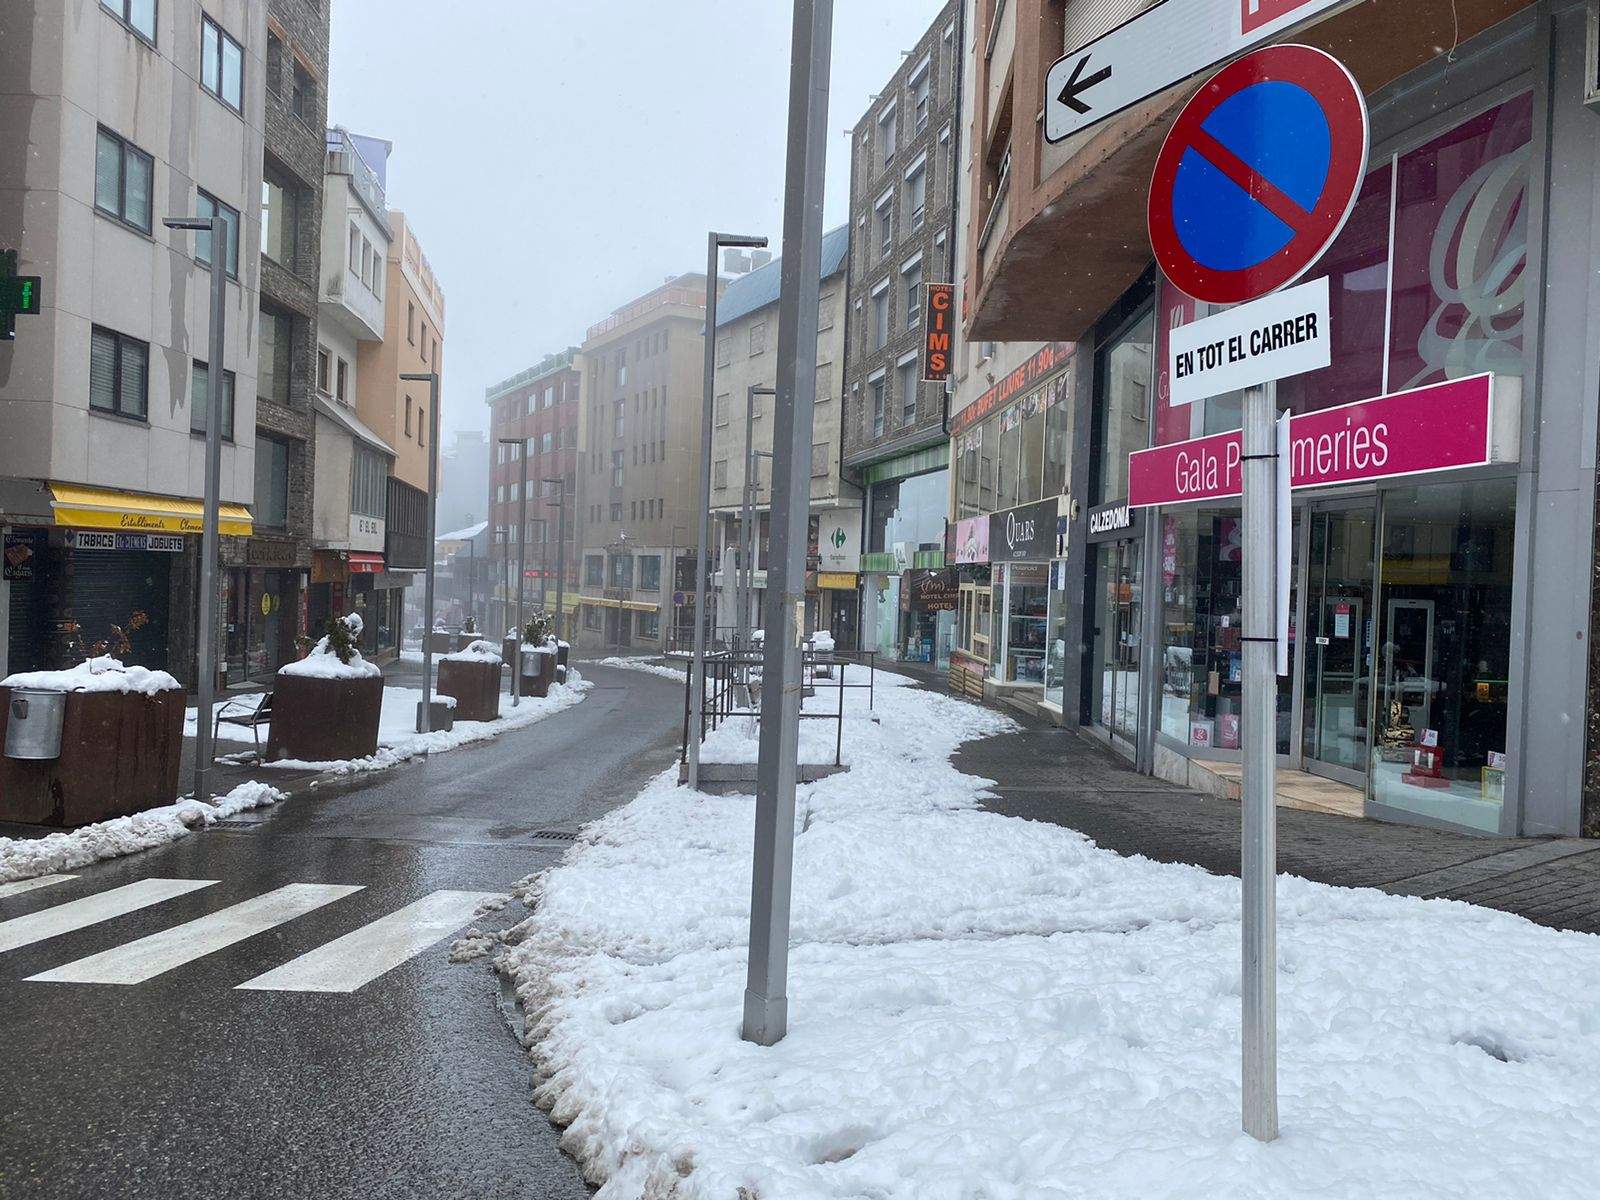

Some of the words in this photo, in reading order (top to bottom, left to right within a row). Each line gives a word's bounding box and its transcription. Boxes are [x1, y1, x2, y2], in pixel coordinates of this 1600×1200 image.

[929, 291, 949, 372] CIMS
[1175, 350, 1194, 379] EN
[1197, 341, 1225, 372] TOT
[1228, 335, 1247, 363] EL
[1250, 312, 1318, 357] CARRER
[1175, 448, 1218, 494] Gala
[1226, 417, 1389, 488] Pmeries
[78, 533, 114, 548] TABACS
[1090, 505, 1130, 534] CALZEDONIA
